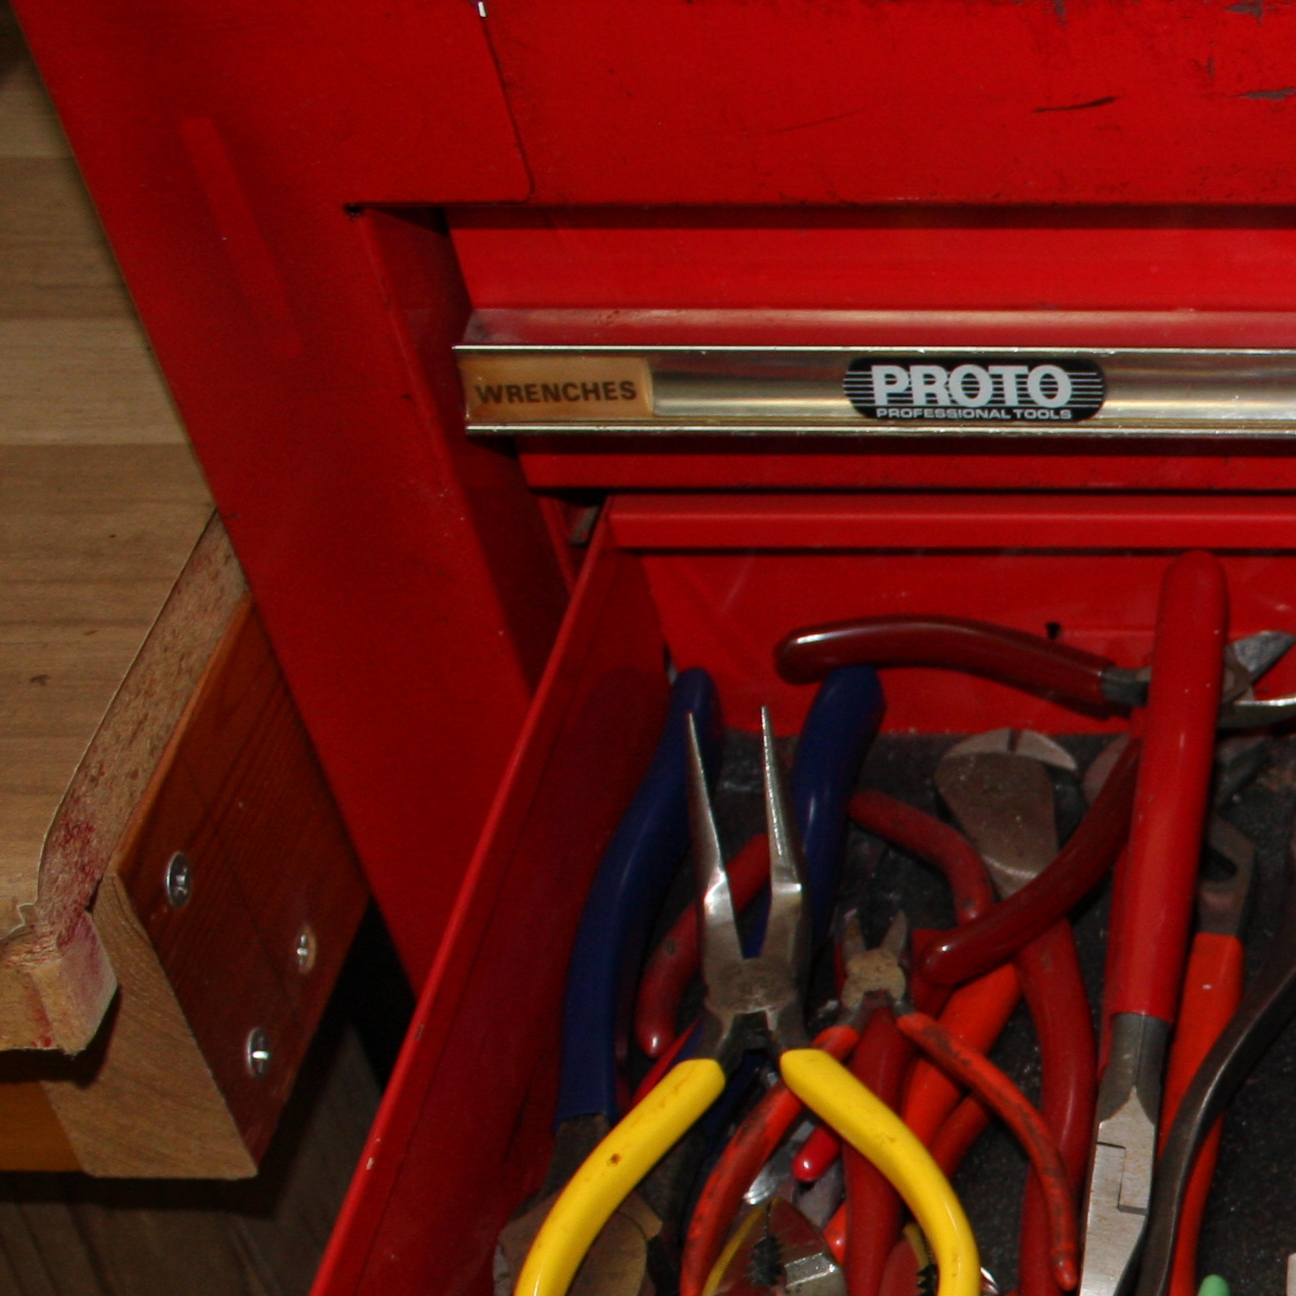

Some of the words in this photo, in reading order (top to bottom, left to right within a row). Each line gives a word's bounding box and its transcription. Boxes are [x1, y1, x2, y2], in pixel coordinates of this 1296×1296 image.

[474, 380, 637, 404] WRENCHES
[871, 364, 1072, 408] PROTO
[876, 407, 1005, 420] PROFESSIONAL
[1013, 409, 1072, 420] TOOLS
